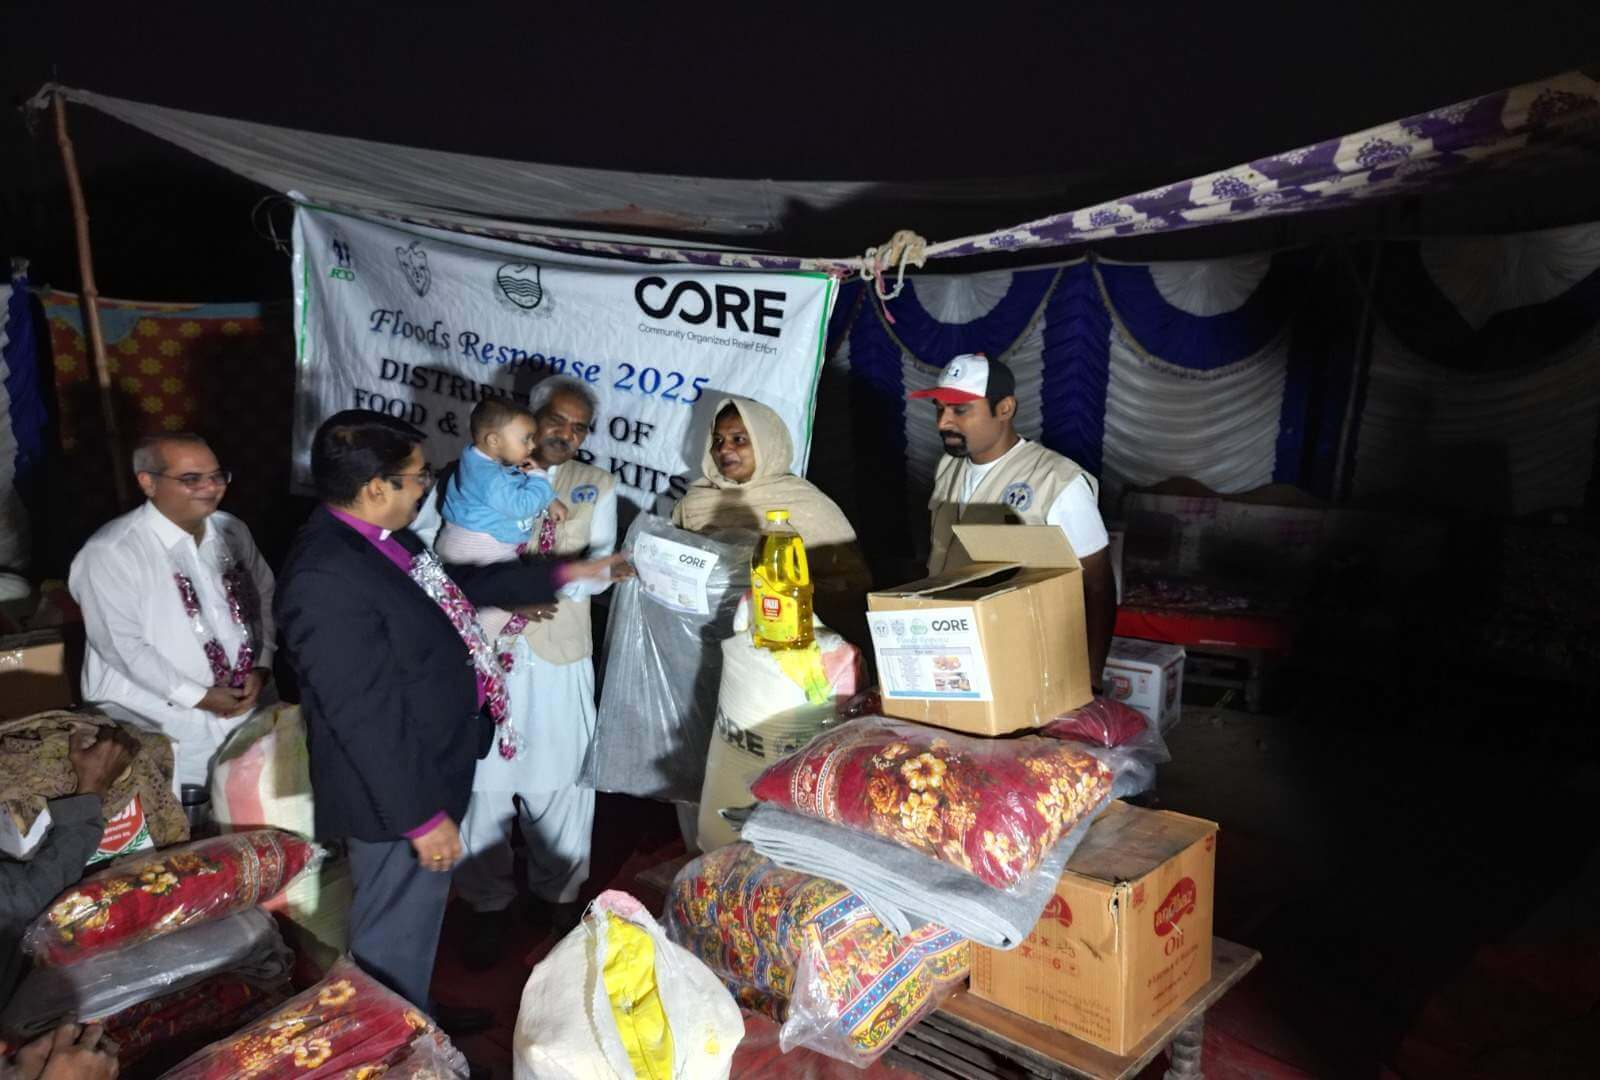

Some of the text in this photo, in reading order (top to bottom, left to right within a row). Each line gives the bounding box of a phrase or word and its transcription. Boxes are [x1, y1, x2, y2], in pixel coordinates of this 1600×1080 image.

[635, 276, 786, 338] CORE
[370, 308, 709, 404] Floods Response 2025
[638, 323, 778, 355] Community Organized Relief Effort
[354, 388, 460, 437] FOOD &
[608, 416, 655, 446] OF
[609, 457, 690, 501] KITS
[679, 553, 706, 569] CORE
[931, 619, 969, 632] CORE
